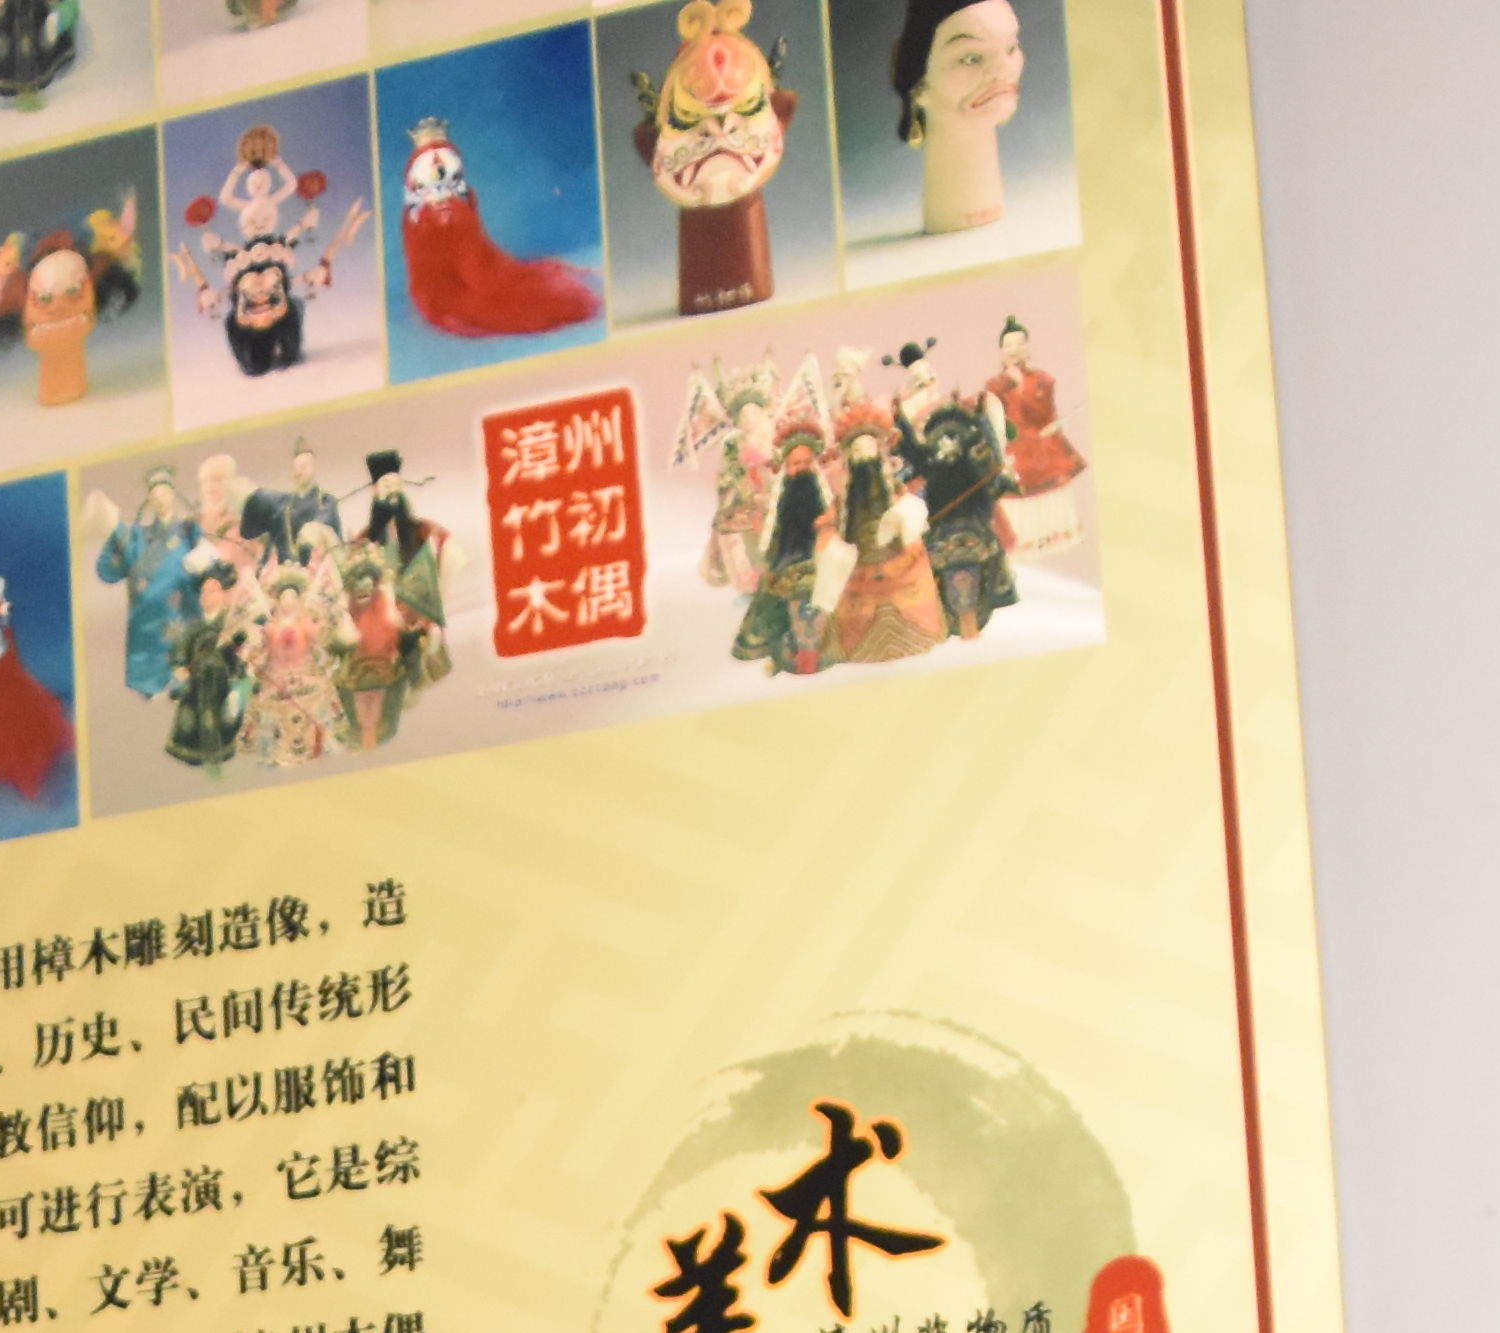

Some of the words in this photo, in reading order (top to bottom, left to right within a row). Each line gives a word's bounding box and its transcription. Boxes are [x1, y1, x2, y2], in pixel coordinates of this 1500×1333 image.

[500, 405, 625, 487] 漳州
[501, 484, 627, 562] 竹初
[506, 559, 634, 637] 木偶
